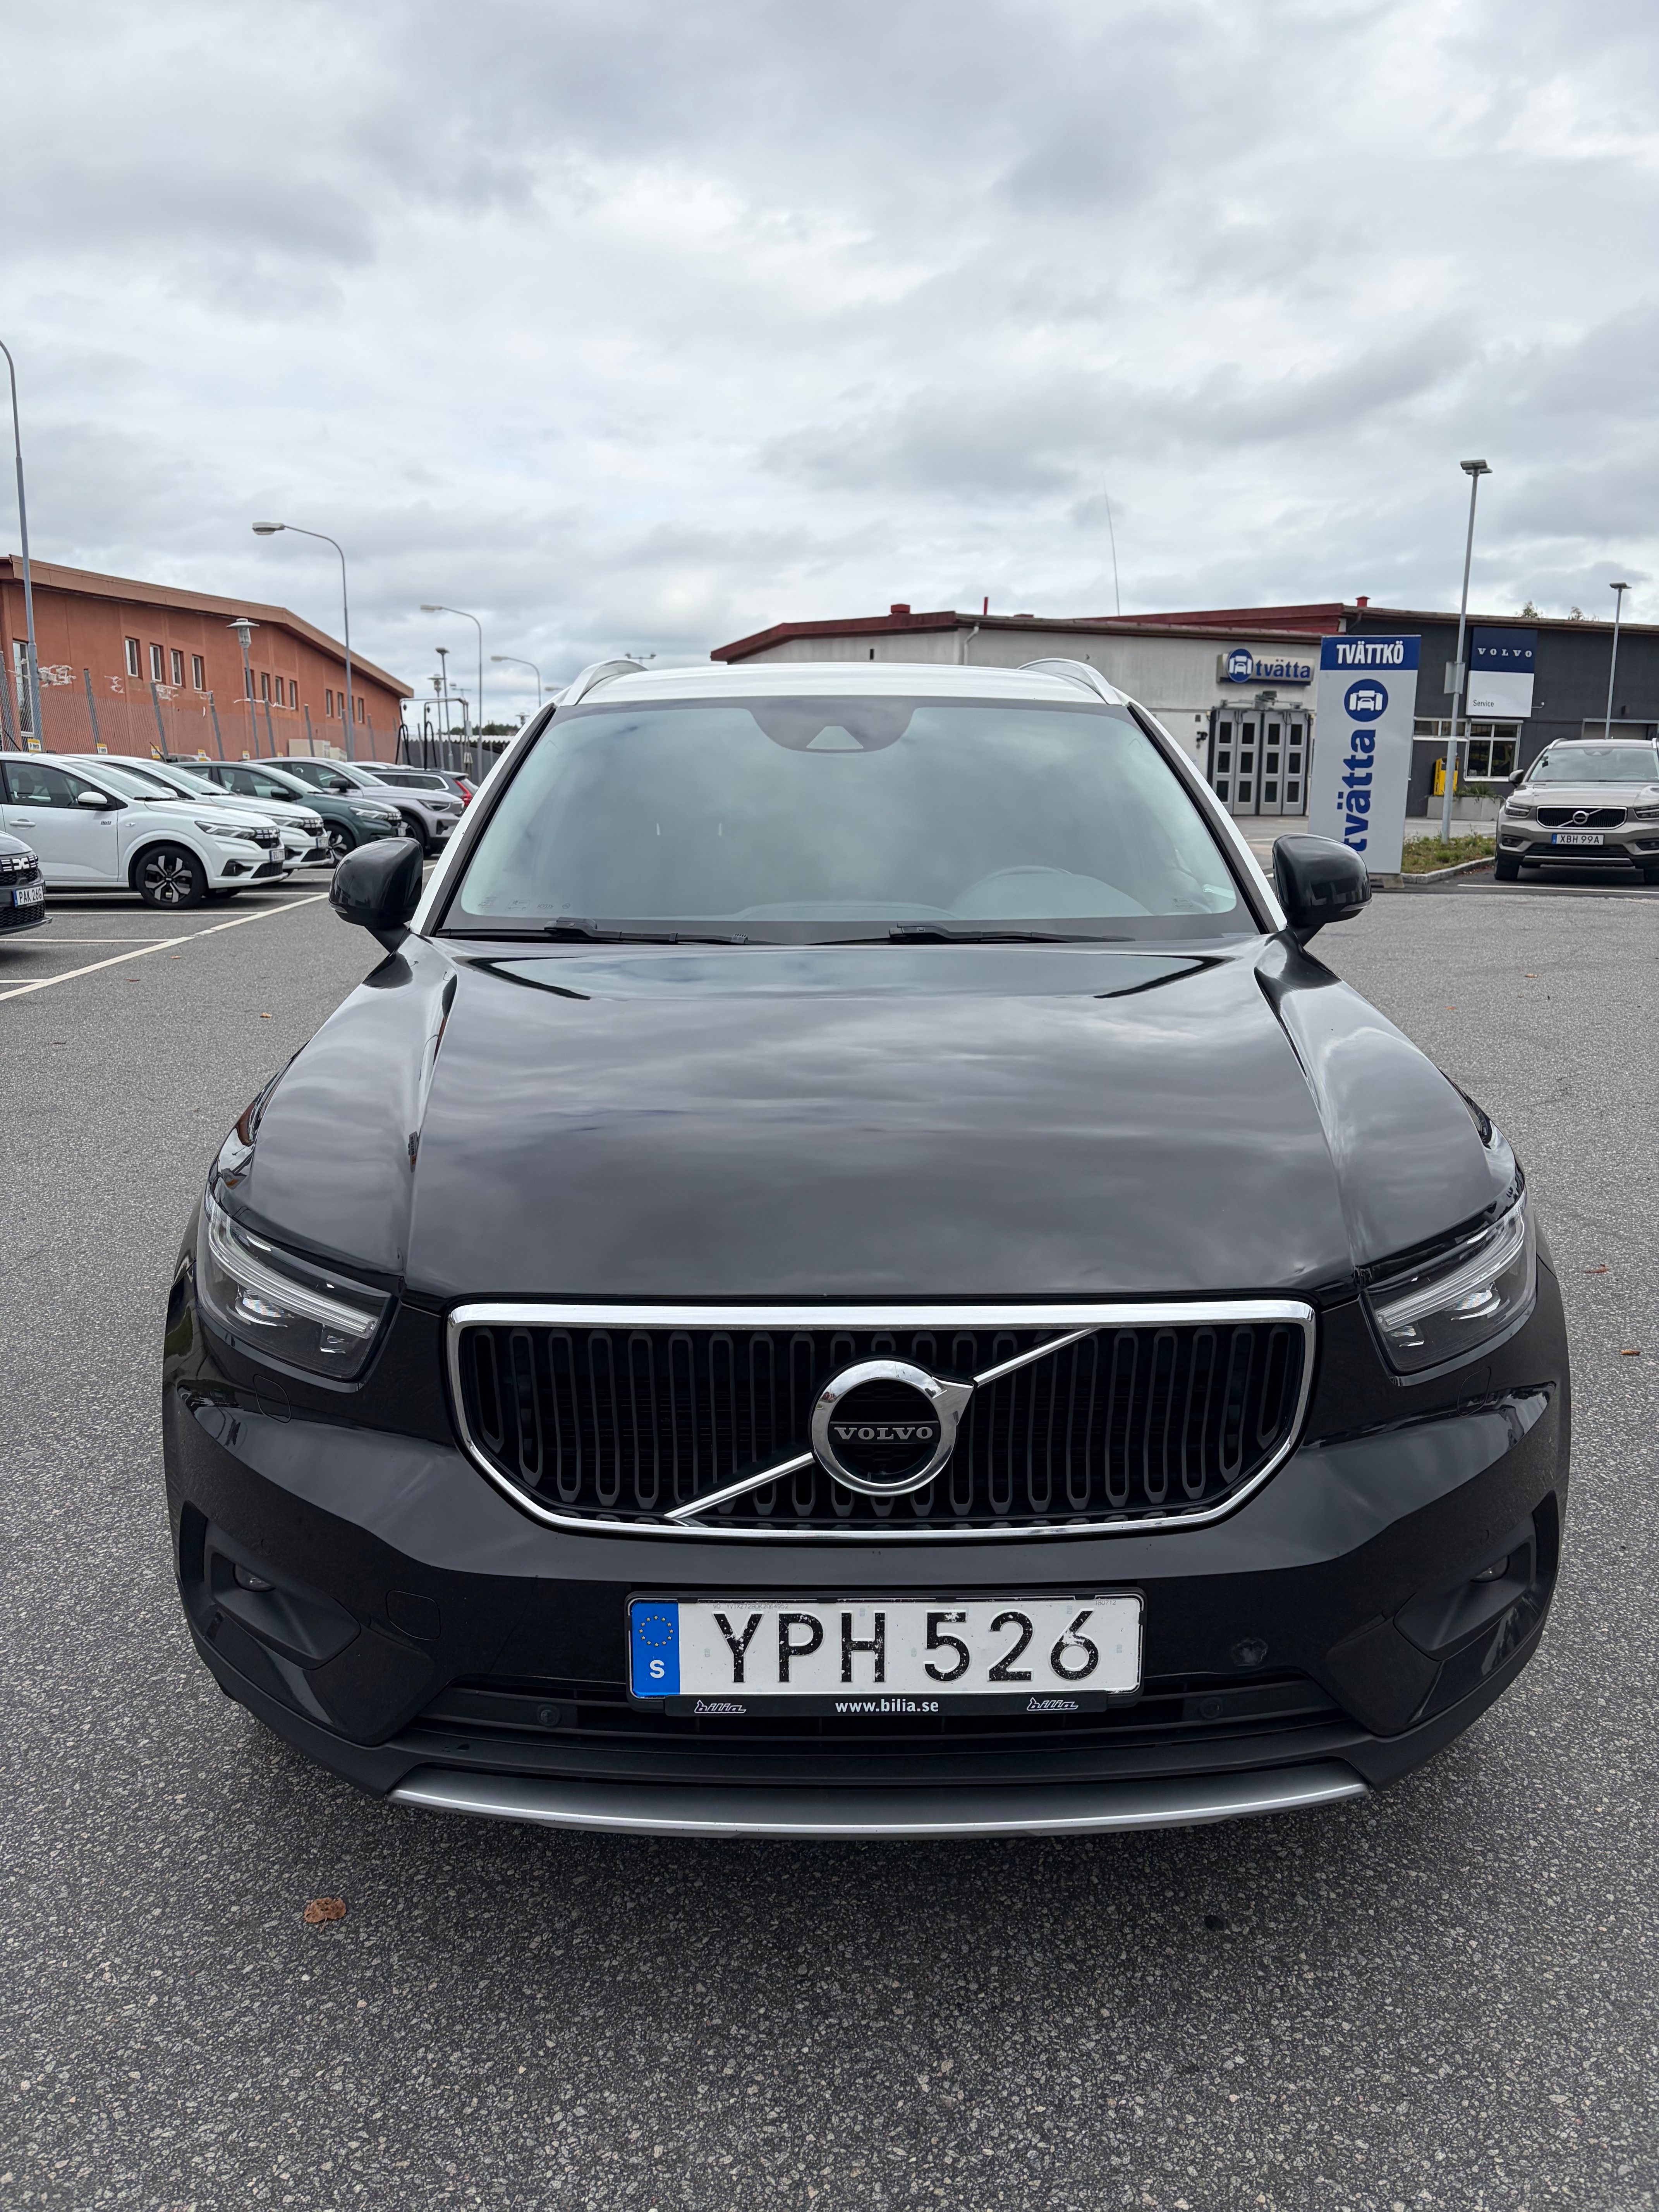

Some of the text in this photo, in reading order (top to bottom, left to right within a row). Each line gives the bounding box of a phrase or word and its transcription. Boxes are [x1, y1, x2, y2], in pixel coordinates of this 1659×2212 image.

[1336, 641, 1404, 664] TVÄTTKÖ
[1477, 647, 1532, 658] VOLVO
[1256, 659, 1310, 678] tvätta
[1337, 730, 1376, 852] tvätta
[1560, 835, 1578, 843] XBH
[19, 888, 42, 903] PAK 26G
[834, 1427, 933, 1440] VOLVO
[712, 1610, 1099, 1683] YPH 526
[650, 1659, 665, 1679] S
[694, 1700, 747, 1714] bilia
[835, 1699, 939, 1712] www.bilia.se
[1027, 1697, 1079, 1711] bilia
